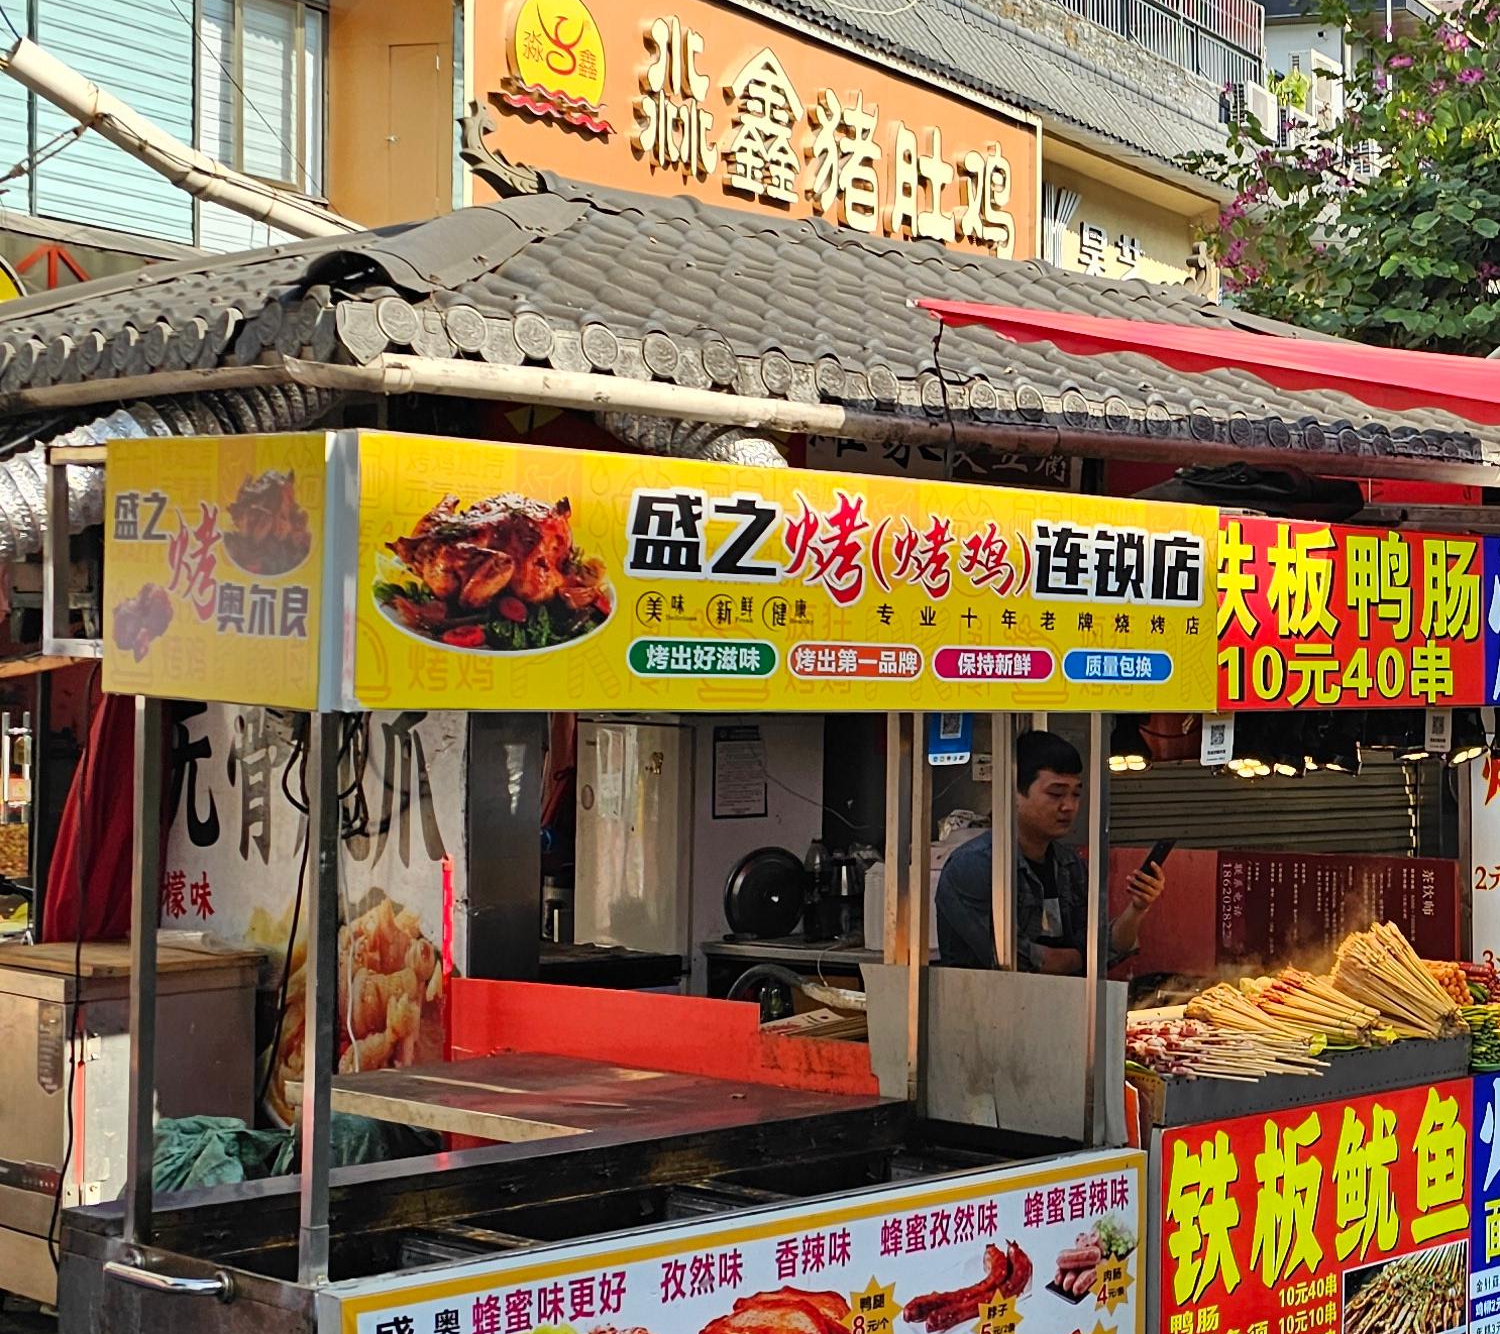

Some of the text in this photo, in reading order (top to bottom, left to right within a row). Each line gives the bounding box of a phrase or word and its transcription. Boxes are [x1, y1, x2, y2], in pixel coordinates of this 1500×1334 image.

[634, 15, 1017, 260] 淼鑫猪肚鸡
[217, 582, 308, 637] 奥尔良
[877, 604, 1200, 635] 专业十年老牌烧烤店
[646, 644, 1153, 679] 烤出好滋味 烤出第一品牌 保持新鲜 质量包换
[1217, 641, 1454, 704] 10元40串
[1166, 1086, 1471, 1307] 铁板鱿鱼
[660, 1248, 744, 1304] 孜然味
[775, 1226, 853, 1281] 香辣味
[880, 1199, 998, 1258] 蜂蜜孜然味
[1024, 1174, 1129, 1230] 蜂蜜香辣味
[1278, 1273, 1338, 1309] 10元40串
